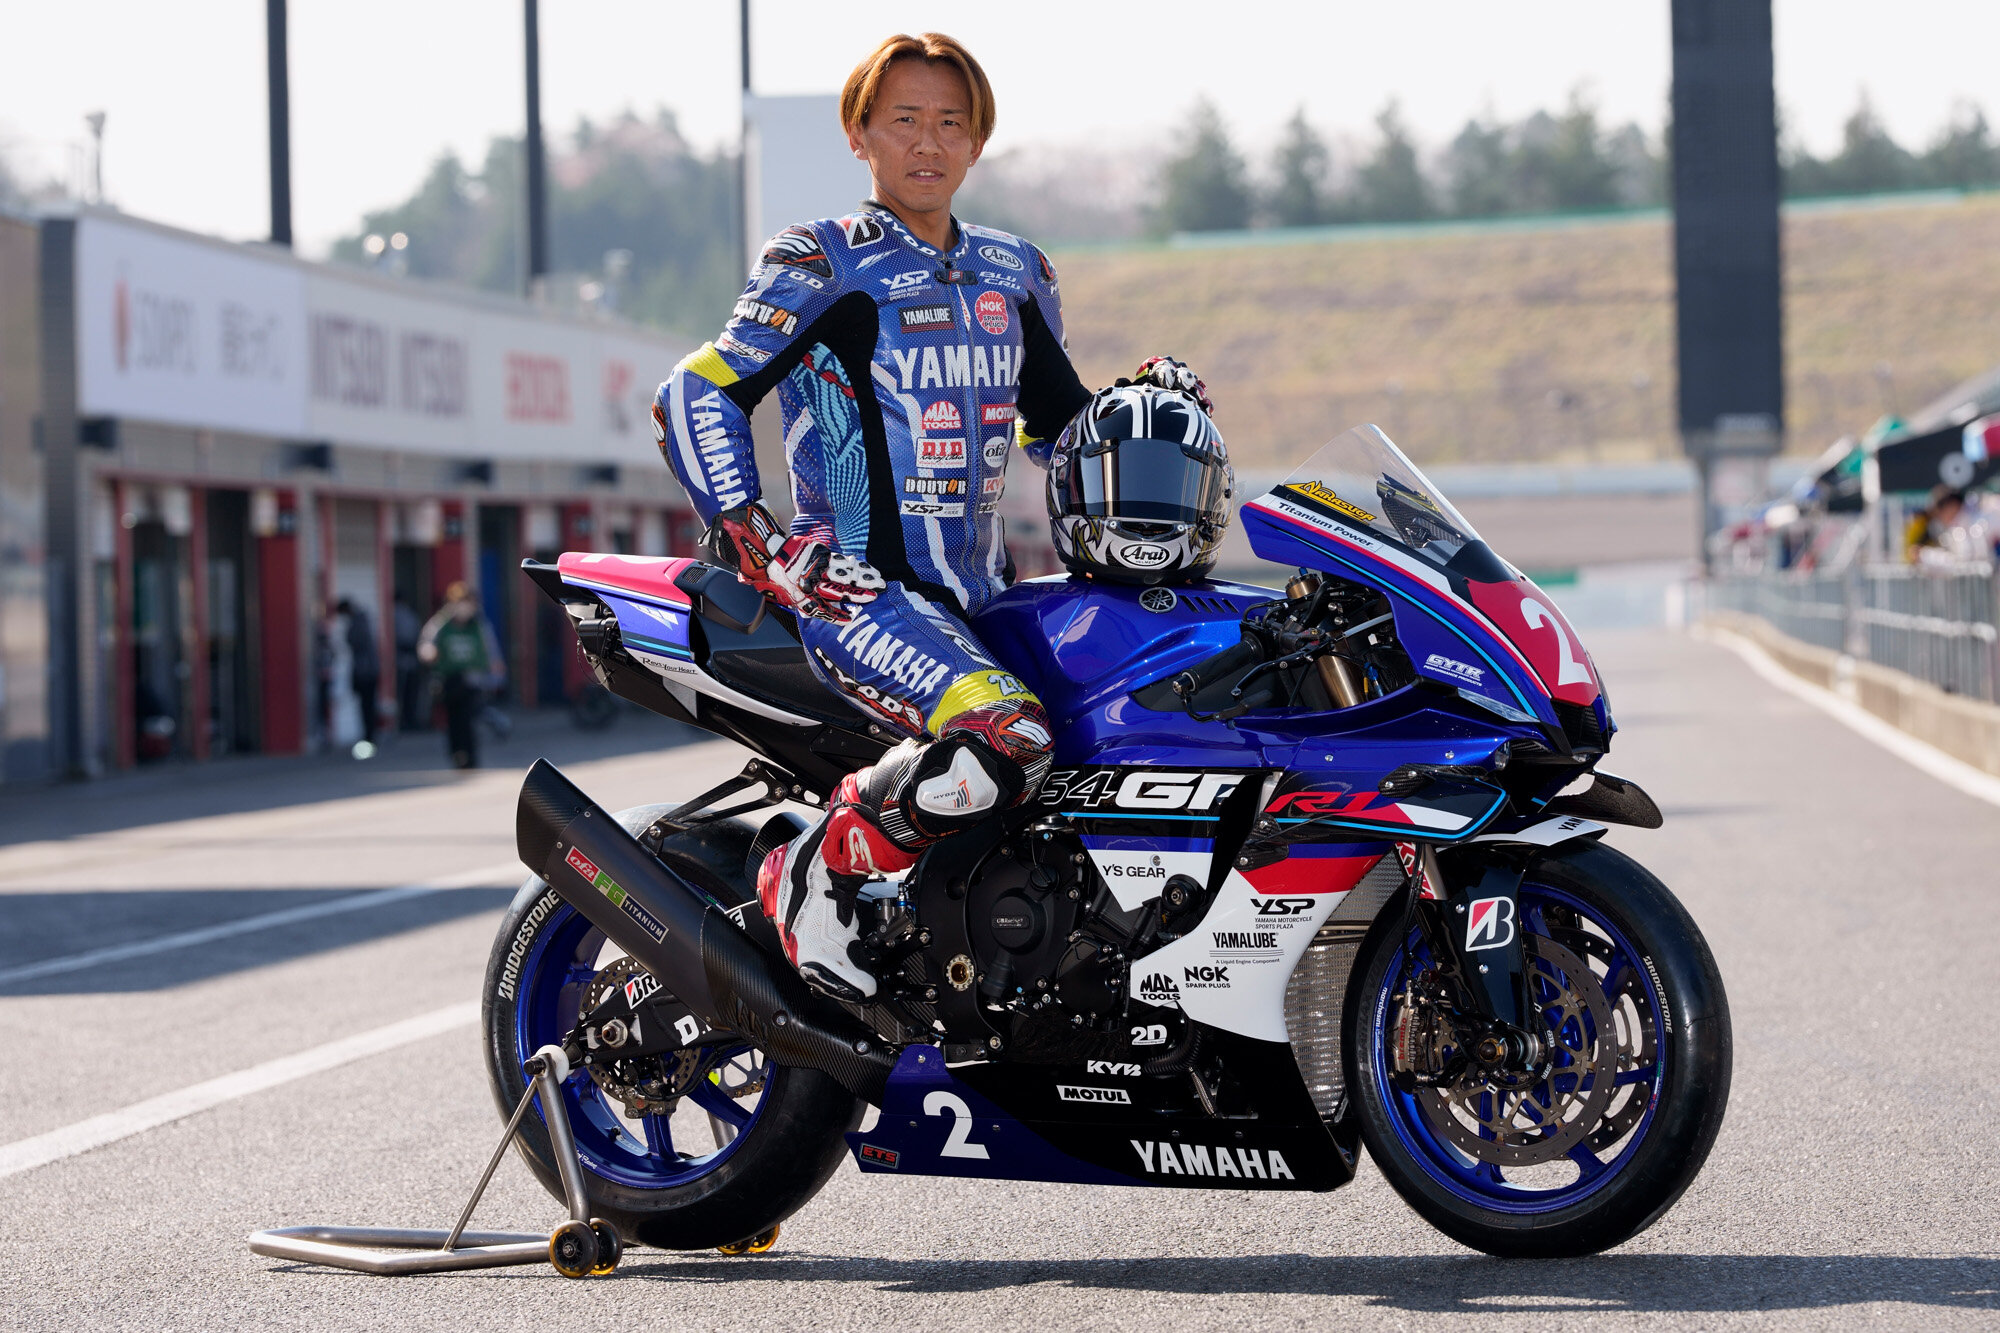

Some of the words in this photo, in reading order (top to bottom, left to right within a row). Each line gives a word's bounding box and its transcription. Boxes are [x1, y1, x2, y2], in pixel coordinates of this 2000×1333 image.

[880, 269, 930, 290] YSP
[903, 307, 951, 325] YAMALUBE
[980, 301, 1003, 312] NGK
[923, 401, 961, 420] MAC
[690, 389, 749, 513] YAMAHA
[904, 503, 944, 514] YSP
[1278, 502, 1333, 530] Titanium
[1334, 525, 1374, 547] Power
[1124, 546, 1165, 561] Arai
[836, 604, 950, 697] YAMAHA
[1519, 597, 1593, 687] 2
[1425, 653, 1486, 682] GYTR
[814, 647, 904, 714] HYOD
[1264, 791, 1382, 813] R1
[1102, 863, 1123, 877] Y'S
[1126, 866, 1166, 878] GEAR
[1250, 898, 1316, 916] YSP
[624, 899, 664, 938] TITANIUM
[498, 889, 560, 1002] BRIDGESTONE
[1212, 932, 1278, 949] YAMALUBE
[1140, 973, 1180, 993] MAC
[1183, 966, 1230, 983] NGK
[1140, 993, 1181, 1001] TOOLS
[1643, 955, 1673, 1034] BRIDGESTONE
[1131, 1024, 1168, 1046] 2D
[1398, 1017, 1407, 1060] brembo
[1086, 1060, 1142, 1076] KYB
[1063, 1087, 1127, 1103] MOTUL
[922, 1090, 991, 1160] 2
[863, 1146, 897, 1163] ETS
[1129, 1139, 1296, 1180] YAMAHA
